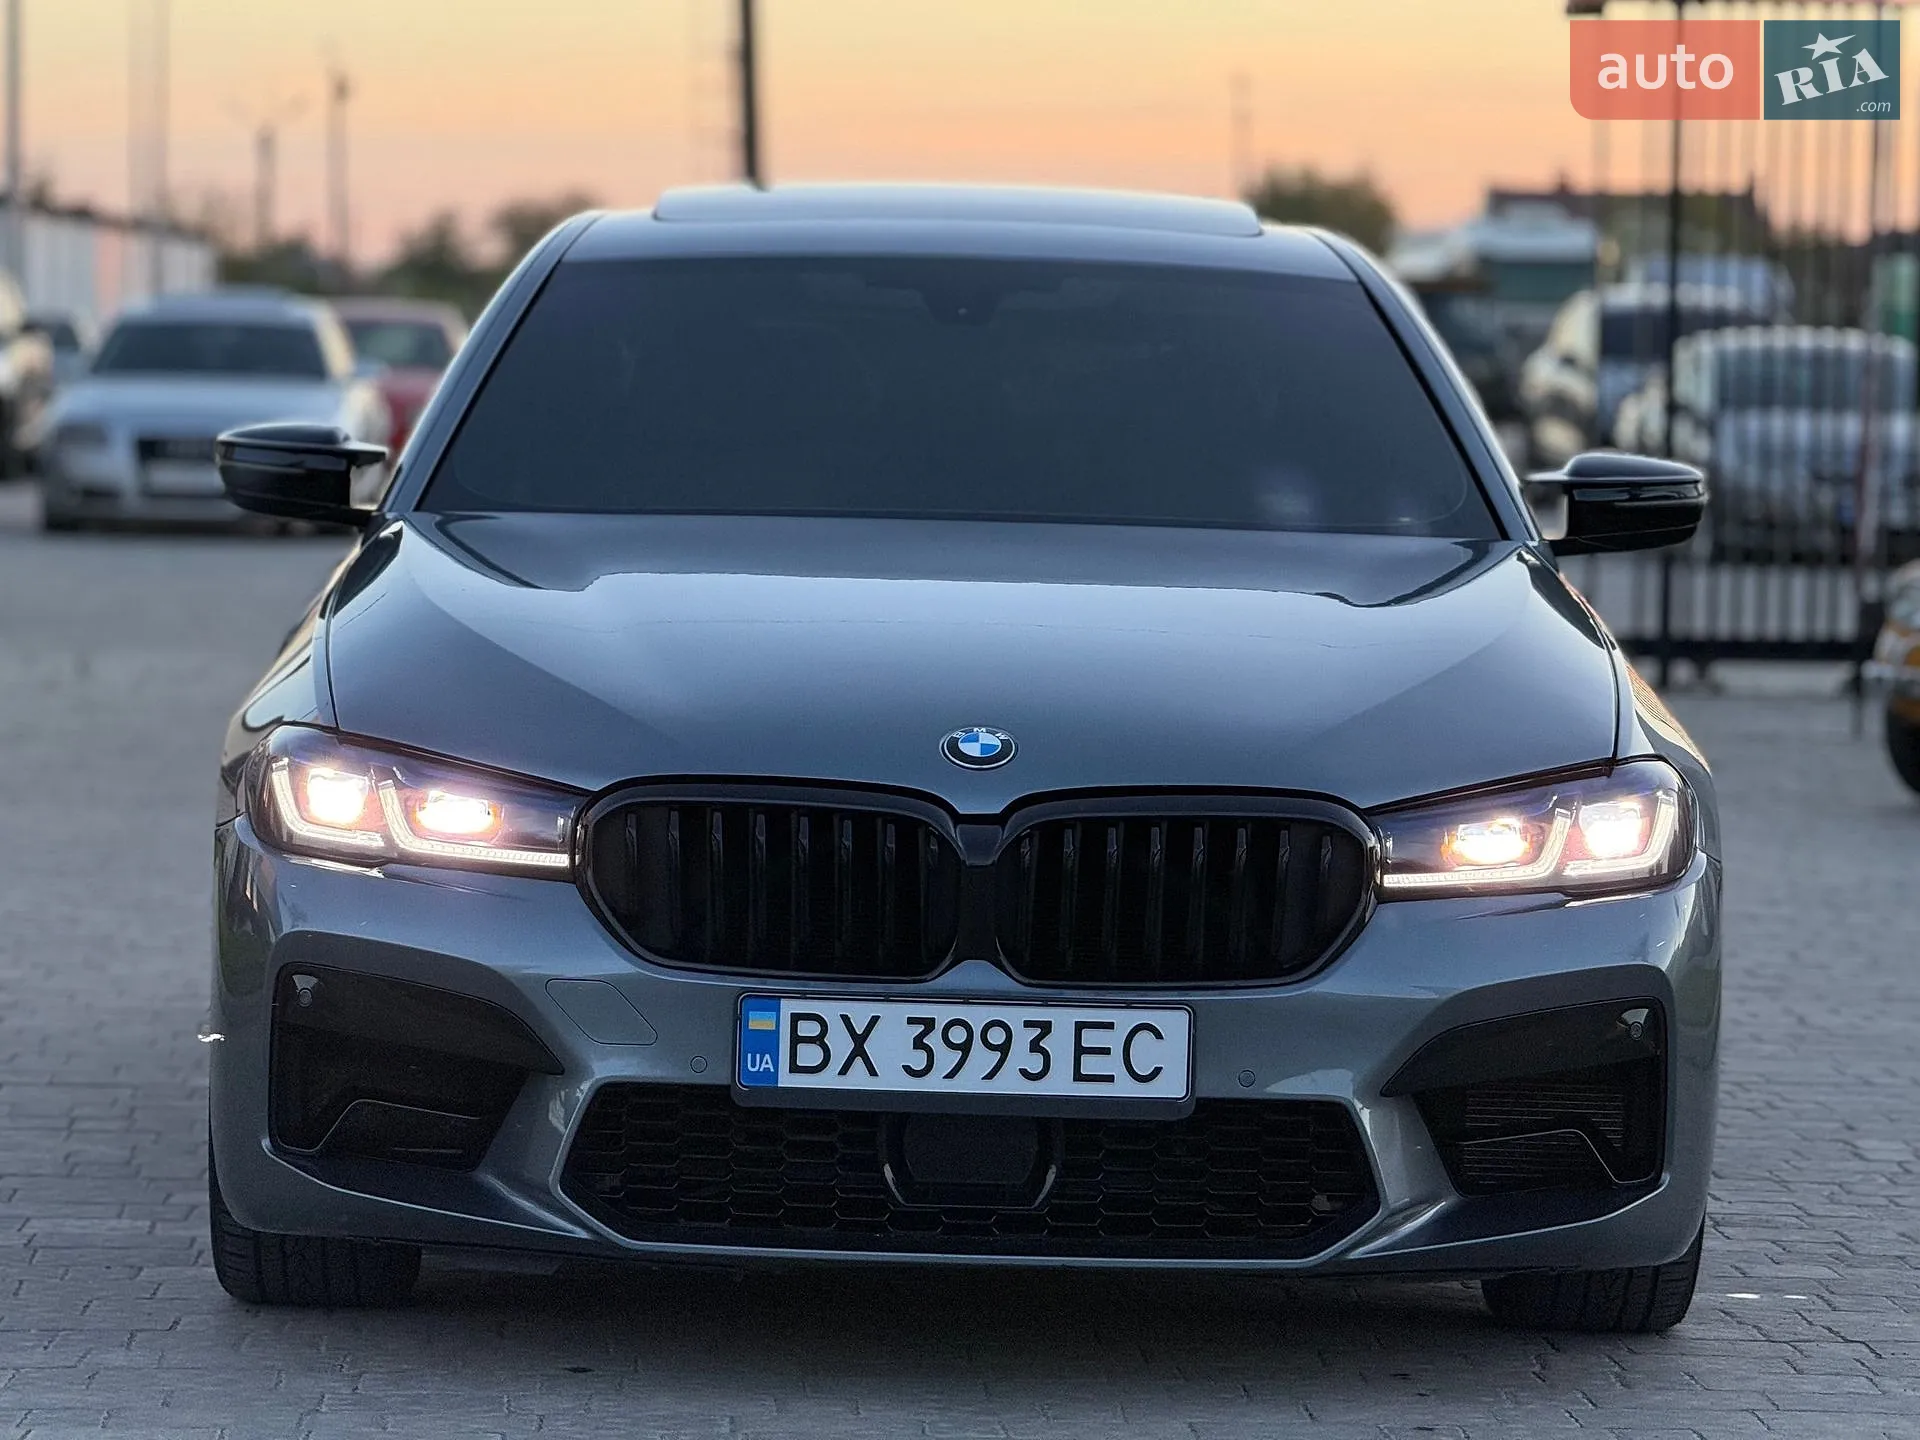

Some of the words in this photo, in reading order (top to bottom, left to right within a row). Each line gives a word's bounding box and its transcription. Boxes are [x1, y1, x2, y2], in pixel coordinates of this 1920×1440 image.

[747, 1053, 774, 1072] UA
[788, 1012, 880, 1077] BX
[901, 1016, 1053, 1082] 3993
[1072, 1020, 1165, 1084] EC
